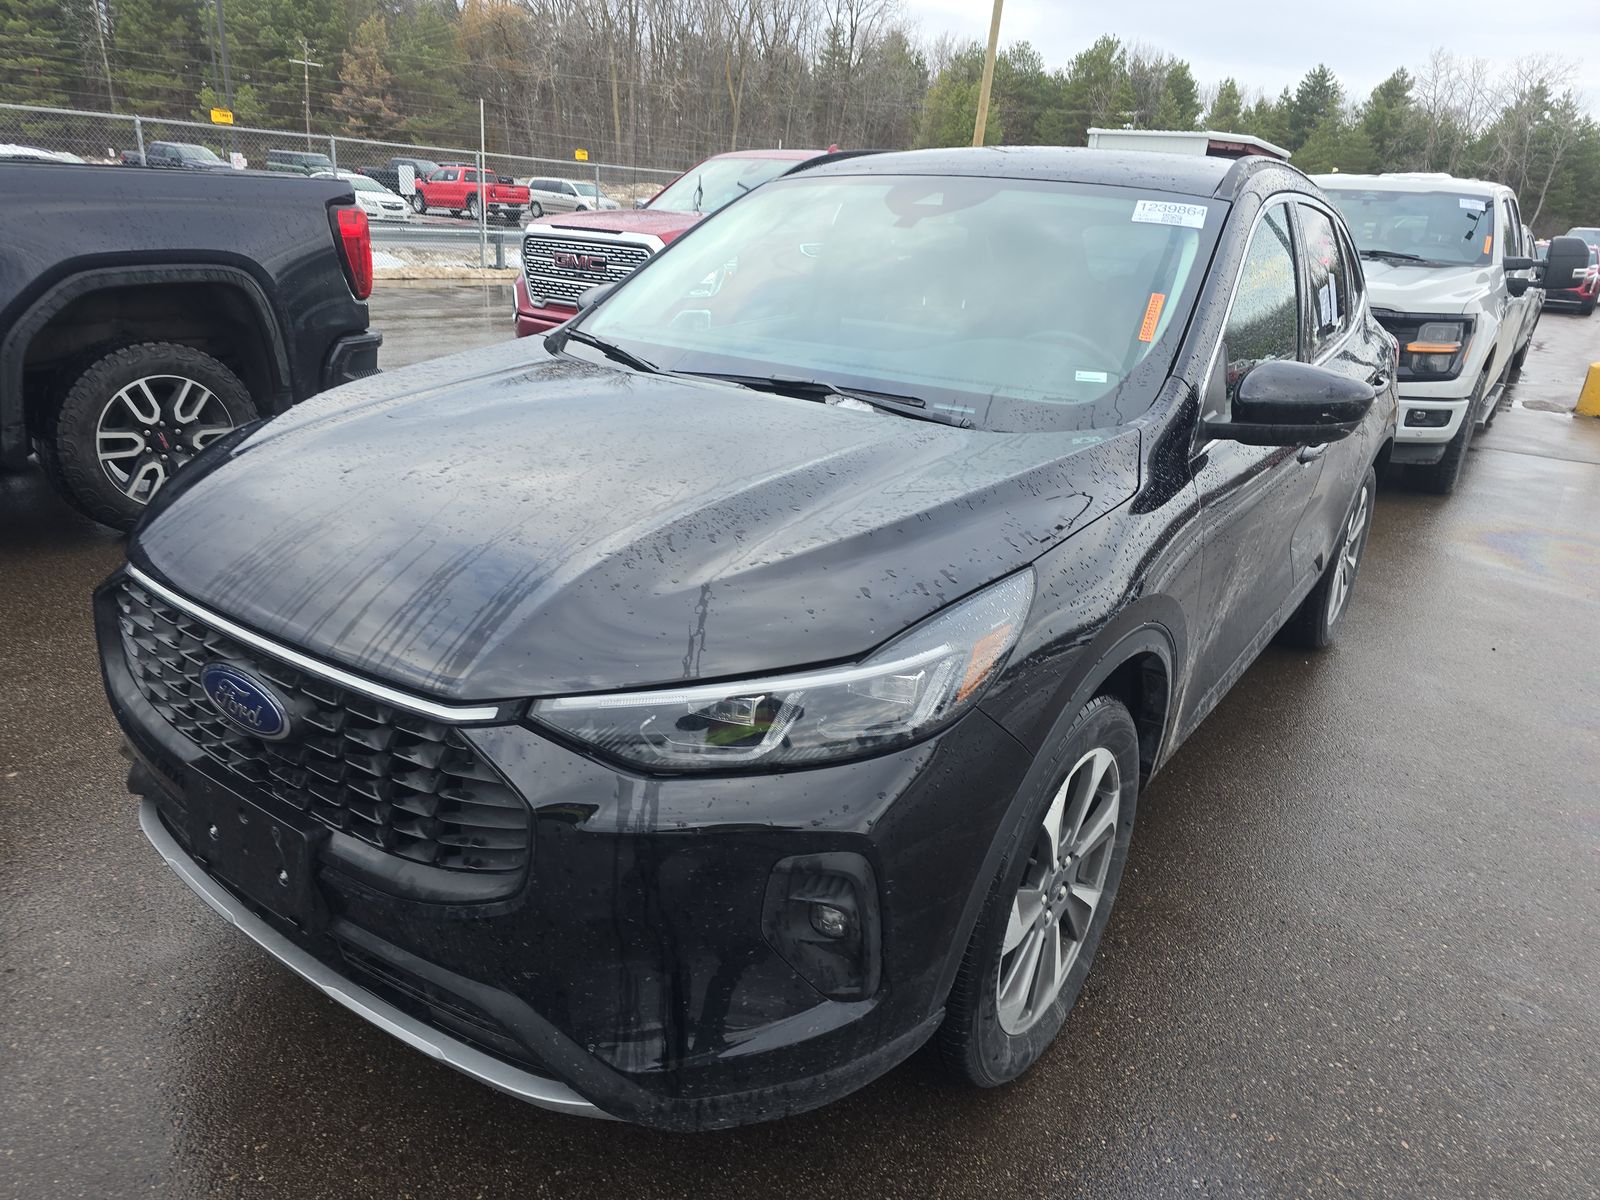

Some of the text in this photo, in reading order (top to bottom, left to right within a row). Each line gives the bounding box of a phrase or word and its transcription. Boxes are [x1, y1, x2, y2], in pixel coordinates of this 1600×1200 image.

[1141, 202, 1206, 217] 1239864
[554, 252, 606, 271] GMC
[215, 679, 263, 727] Ford
